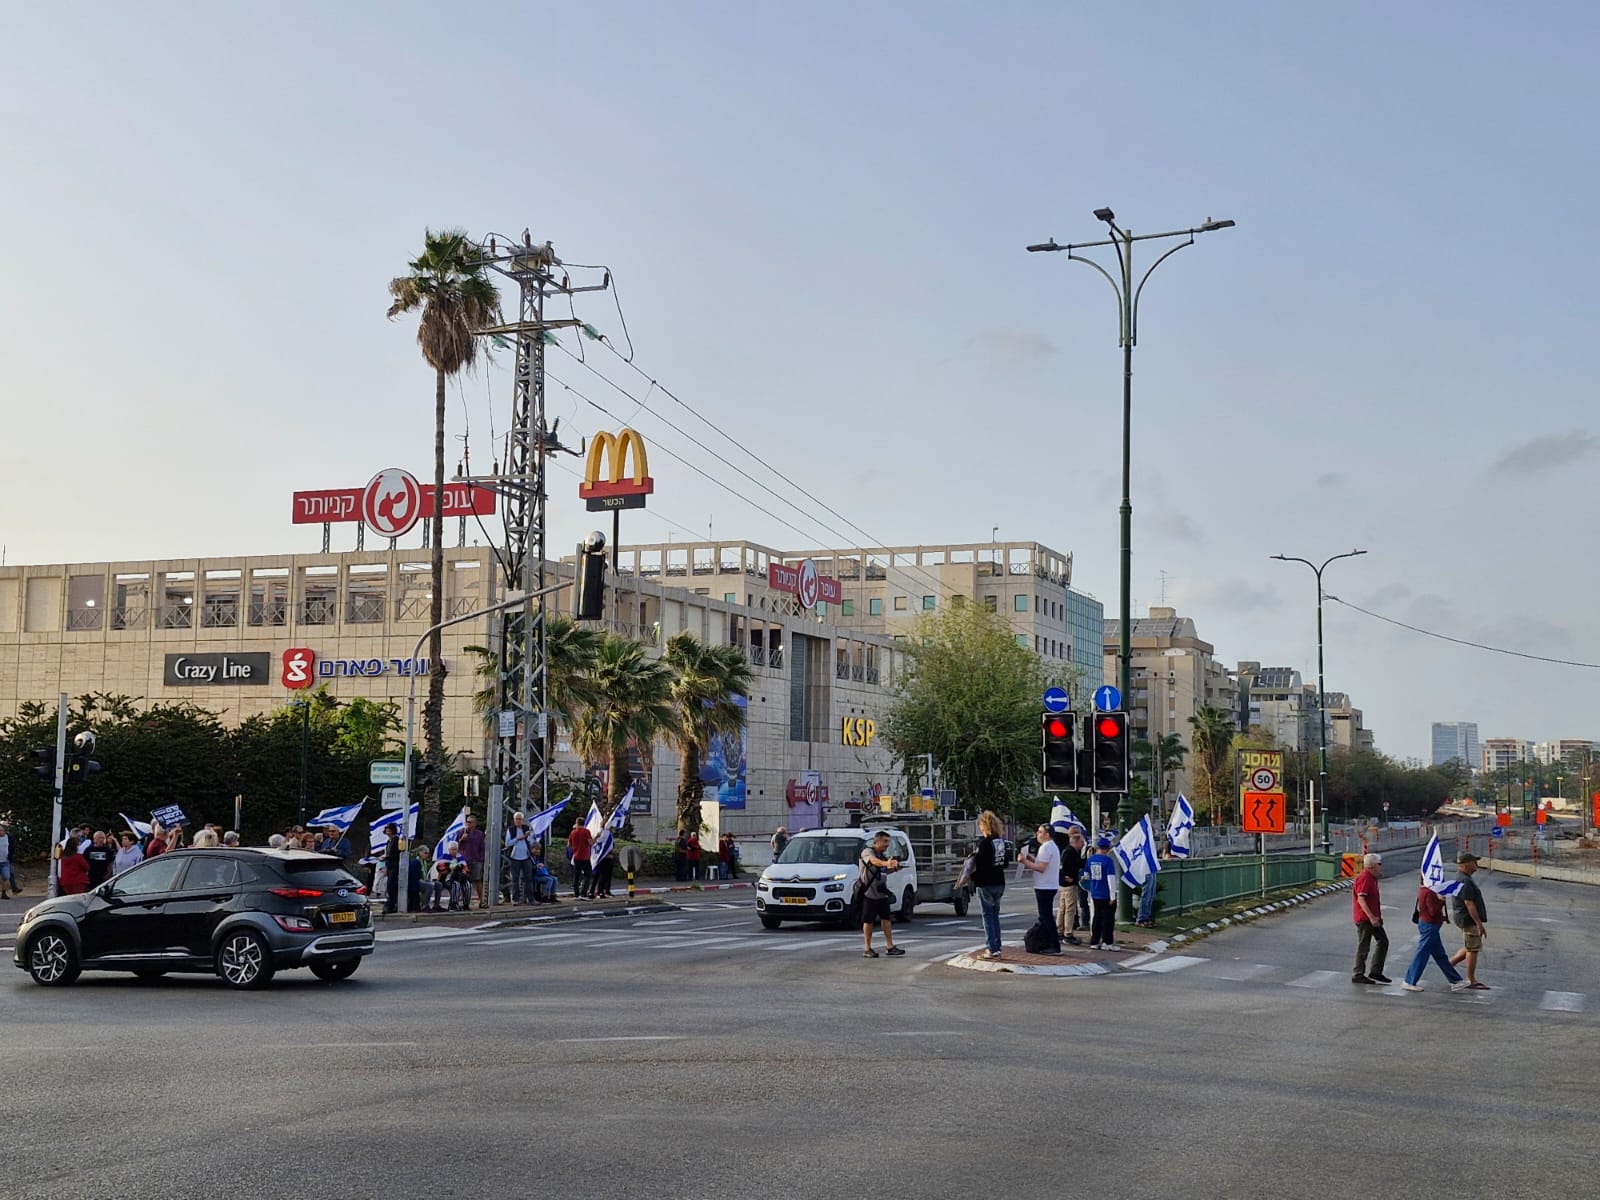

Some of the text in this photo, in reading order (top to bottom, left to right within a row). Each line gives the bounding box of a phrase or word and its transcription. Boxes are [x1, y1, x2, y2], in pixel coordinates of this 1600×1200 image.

[297, 495, 354, 518] קניותר
[602, 498, 625, 507] הכשר
[174, 656, 251, 682] Crazy Line
[1257, 775, 1271, 784] 50
